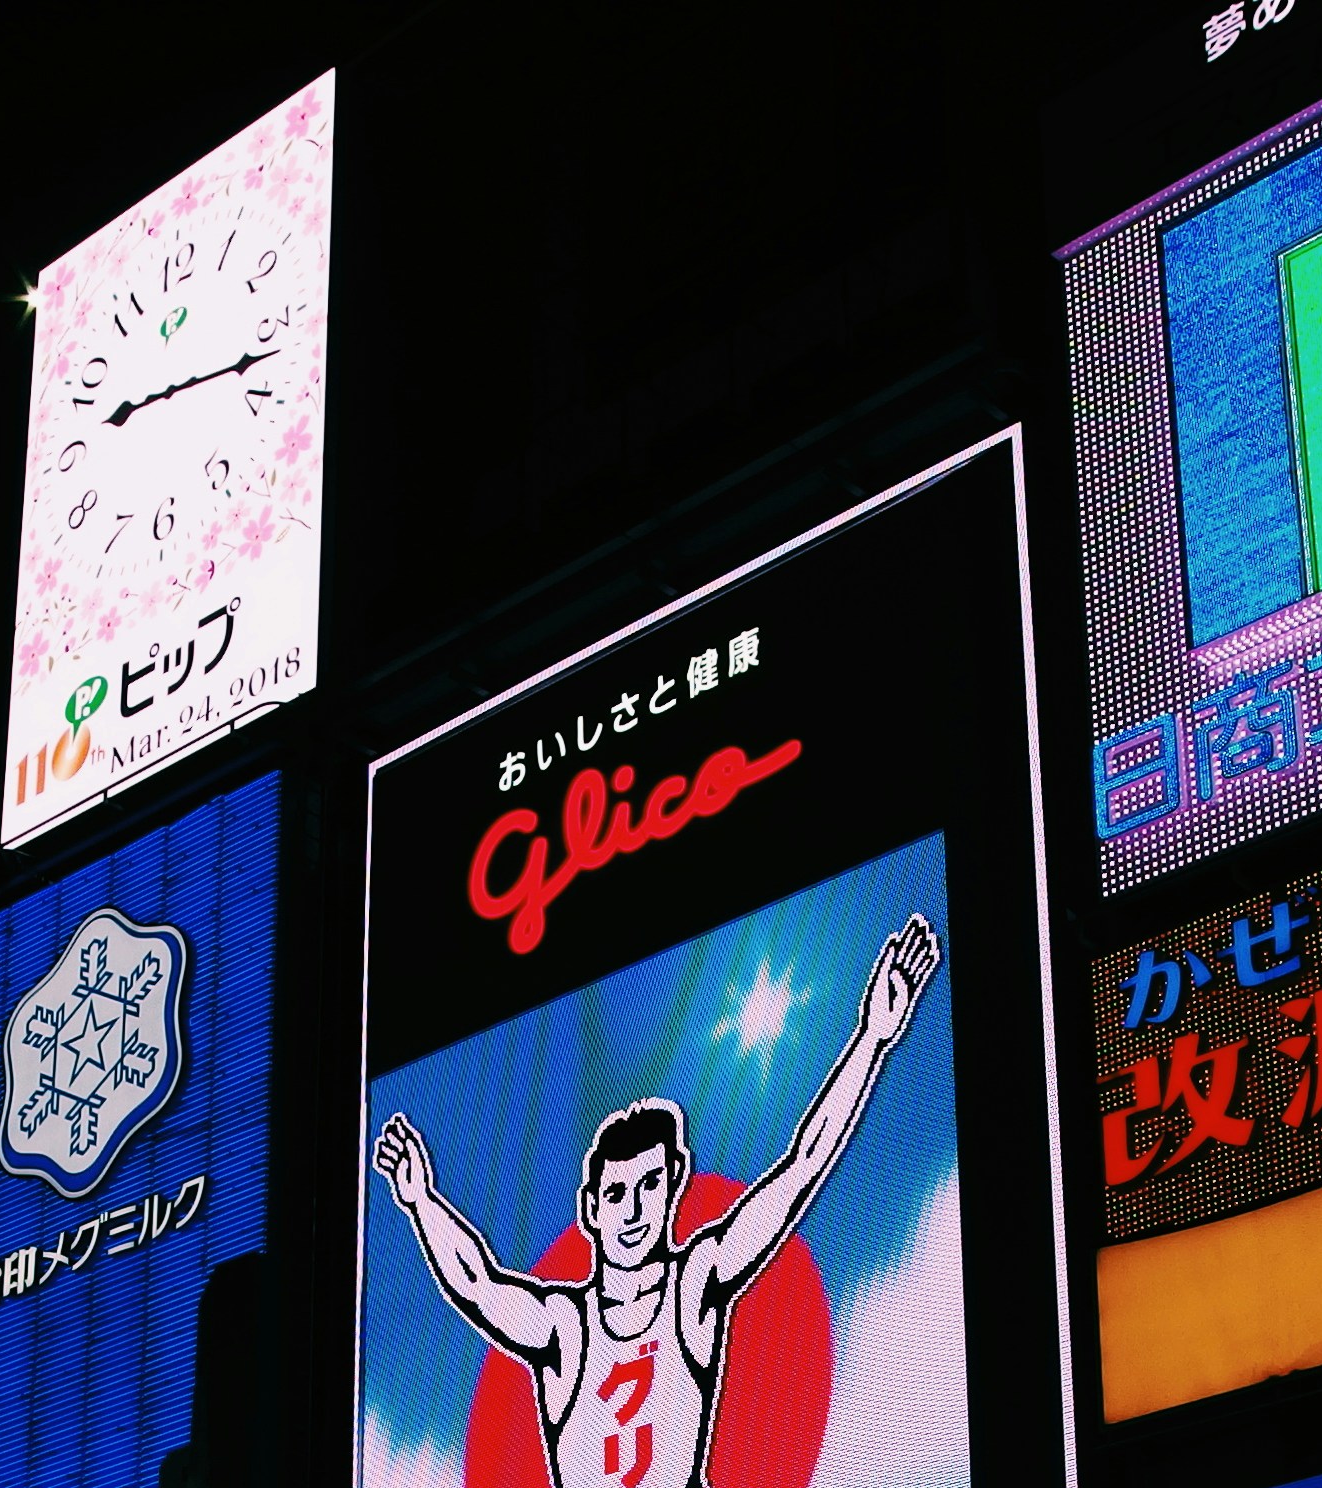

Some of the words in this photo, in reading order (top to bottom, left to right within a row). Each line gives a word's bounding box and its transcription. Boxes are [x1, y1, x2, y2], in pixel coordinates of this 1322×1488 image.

[163, 243, 195, 293] 12
[217, 228, 237, 272] 1
[244, 250, 278, 295] 2
[256, 303, 290, 343] 3
[72, 356, 109, 411] 10
[243, 380, 274, 417] 4
[57, 440, 88, 473] 9
[203, 447, 231, 491] 5
[67, 489, 98, 530] 8
[152, 497, 177, 541] 6
[104, 512, 135, 555] 7
[119, 595, 242, 719] ピップ
[109, 725, 172, 774] Mar.
[178, 695, 221, 735] 24,
[228, 645, 302, 709] 2018
[497, 626, 761, 792] おいしさと健康
